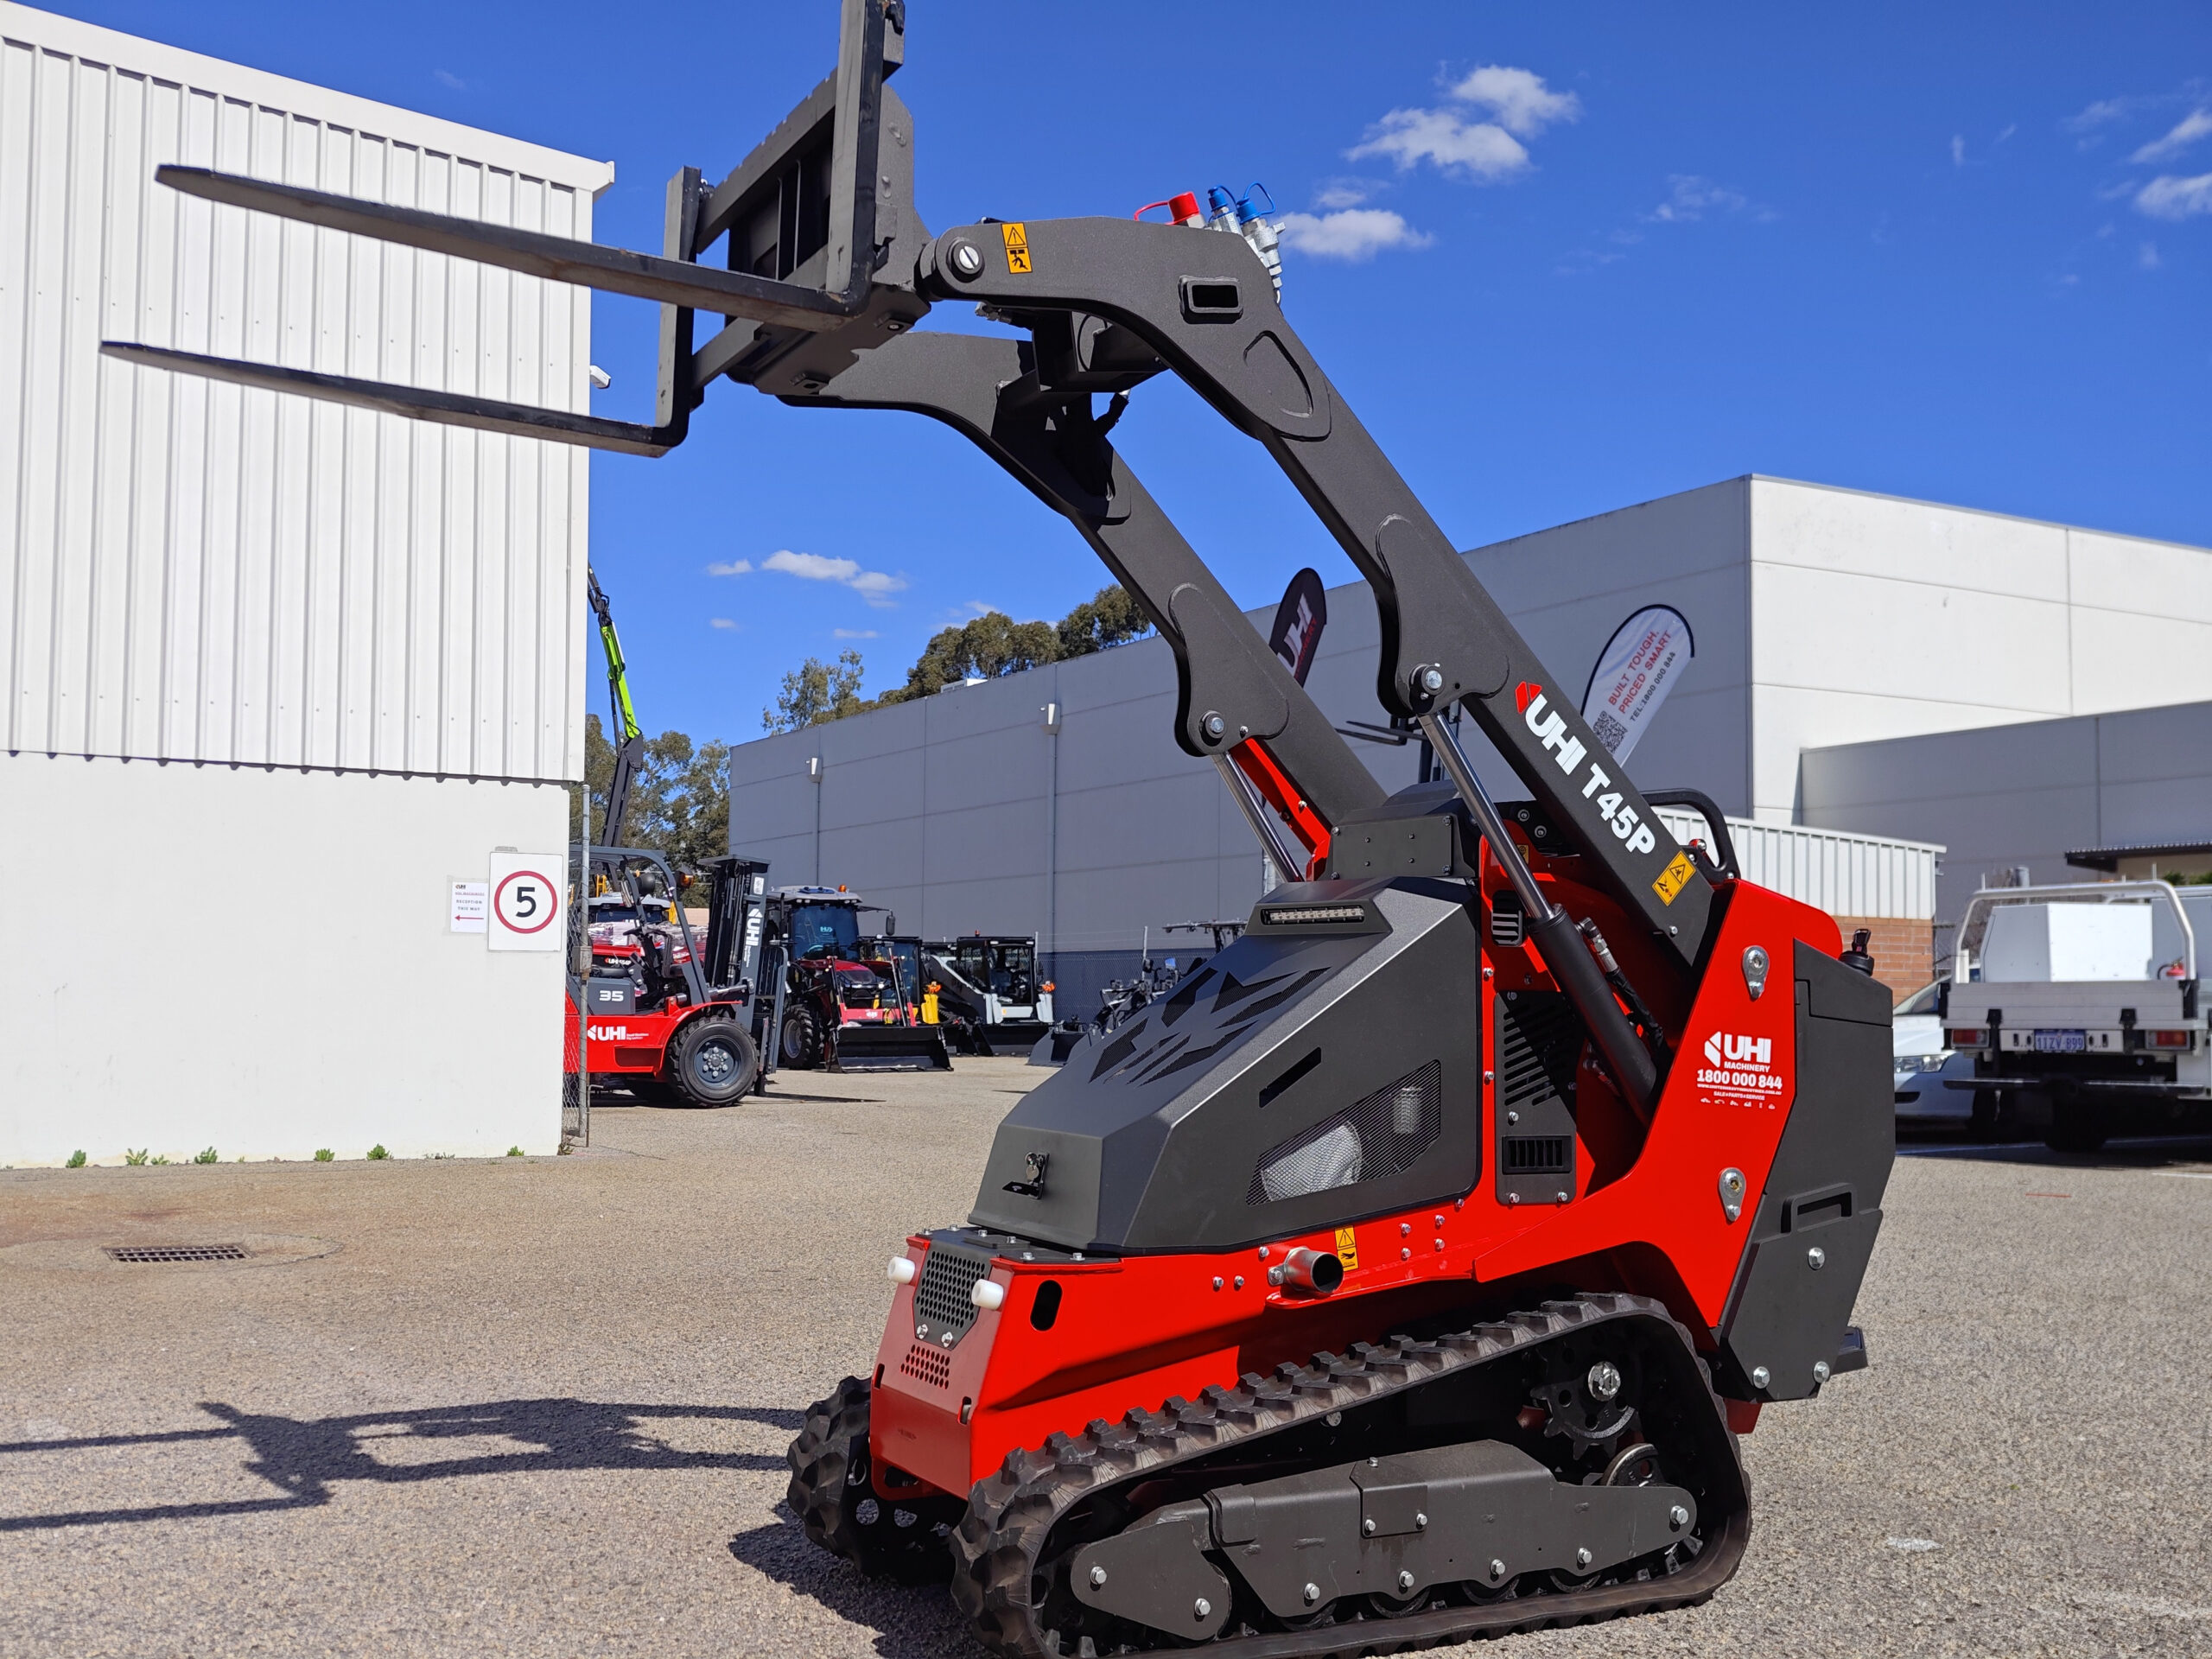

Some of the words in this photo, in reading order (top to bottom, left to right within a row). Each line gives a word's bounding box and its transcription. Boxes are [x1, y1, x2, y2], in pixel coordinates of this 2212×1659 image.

[1608, 672, 1630, 706] BUILT
[1628, 631, 1659, 671] TOUGH.
[1618, 672, 1646, 714] PRICED
[1645, 630, 1672, 671] SMART
[1525, 693, 1587, 775] UHI
[1581, 762, 1656, 855] T45P
[516, 887, 537, 918] 5
[745, 918, 761, 946] UHI
[599, 990, 624, 1001] 35
[597, 1026, 626, 1041] UHI
[1724, 1034, 1771, 1064] UHI
[1696, 1069, 1730, 1084] 1800
[1732, 1071, 1756, 1087] 000
[1758, 1075, 1783, 1090] 844
[1724, 1061, 1770, 1072] MACHINERY
